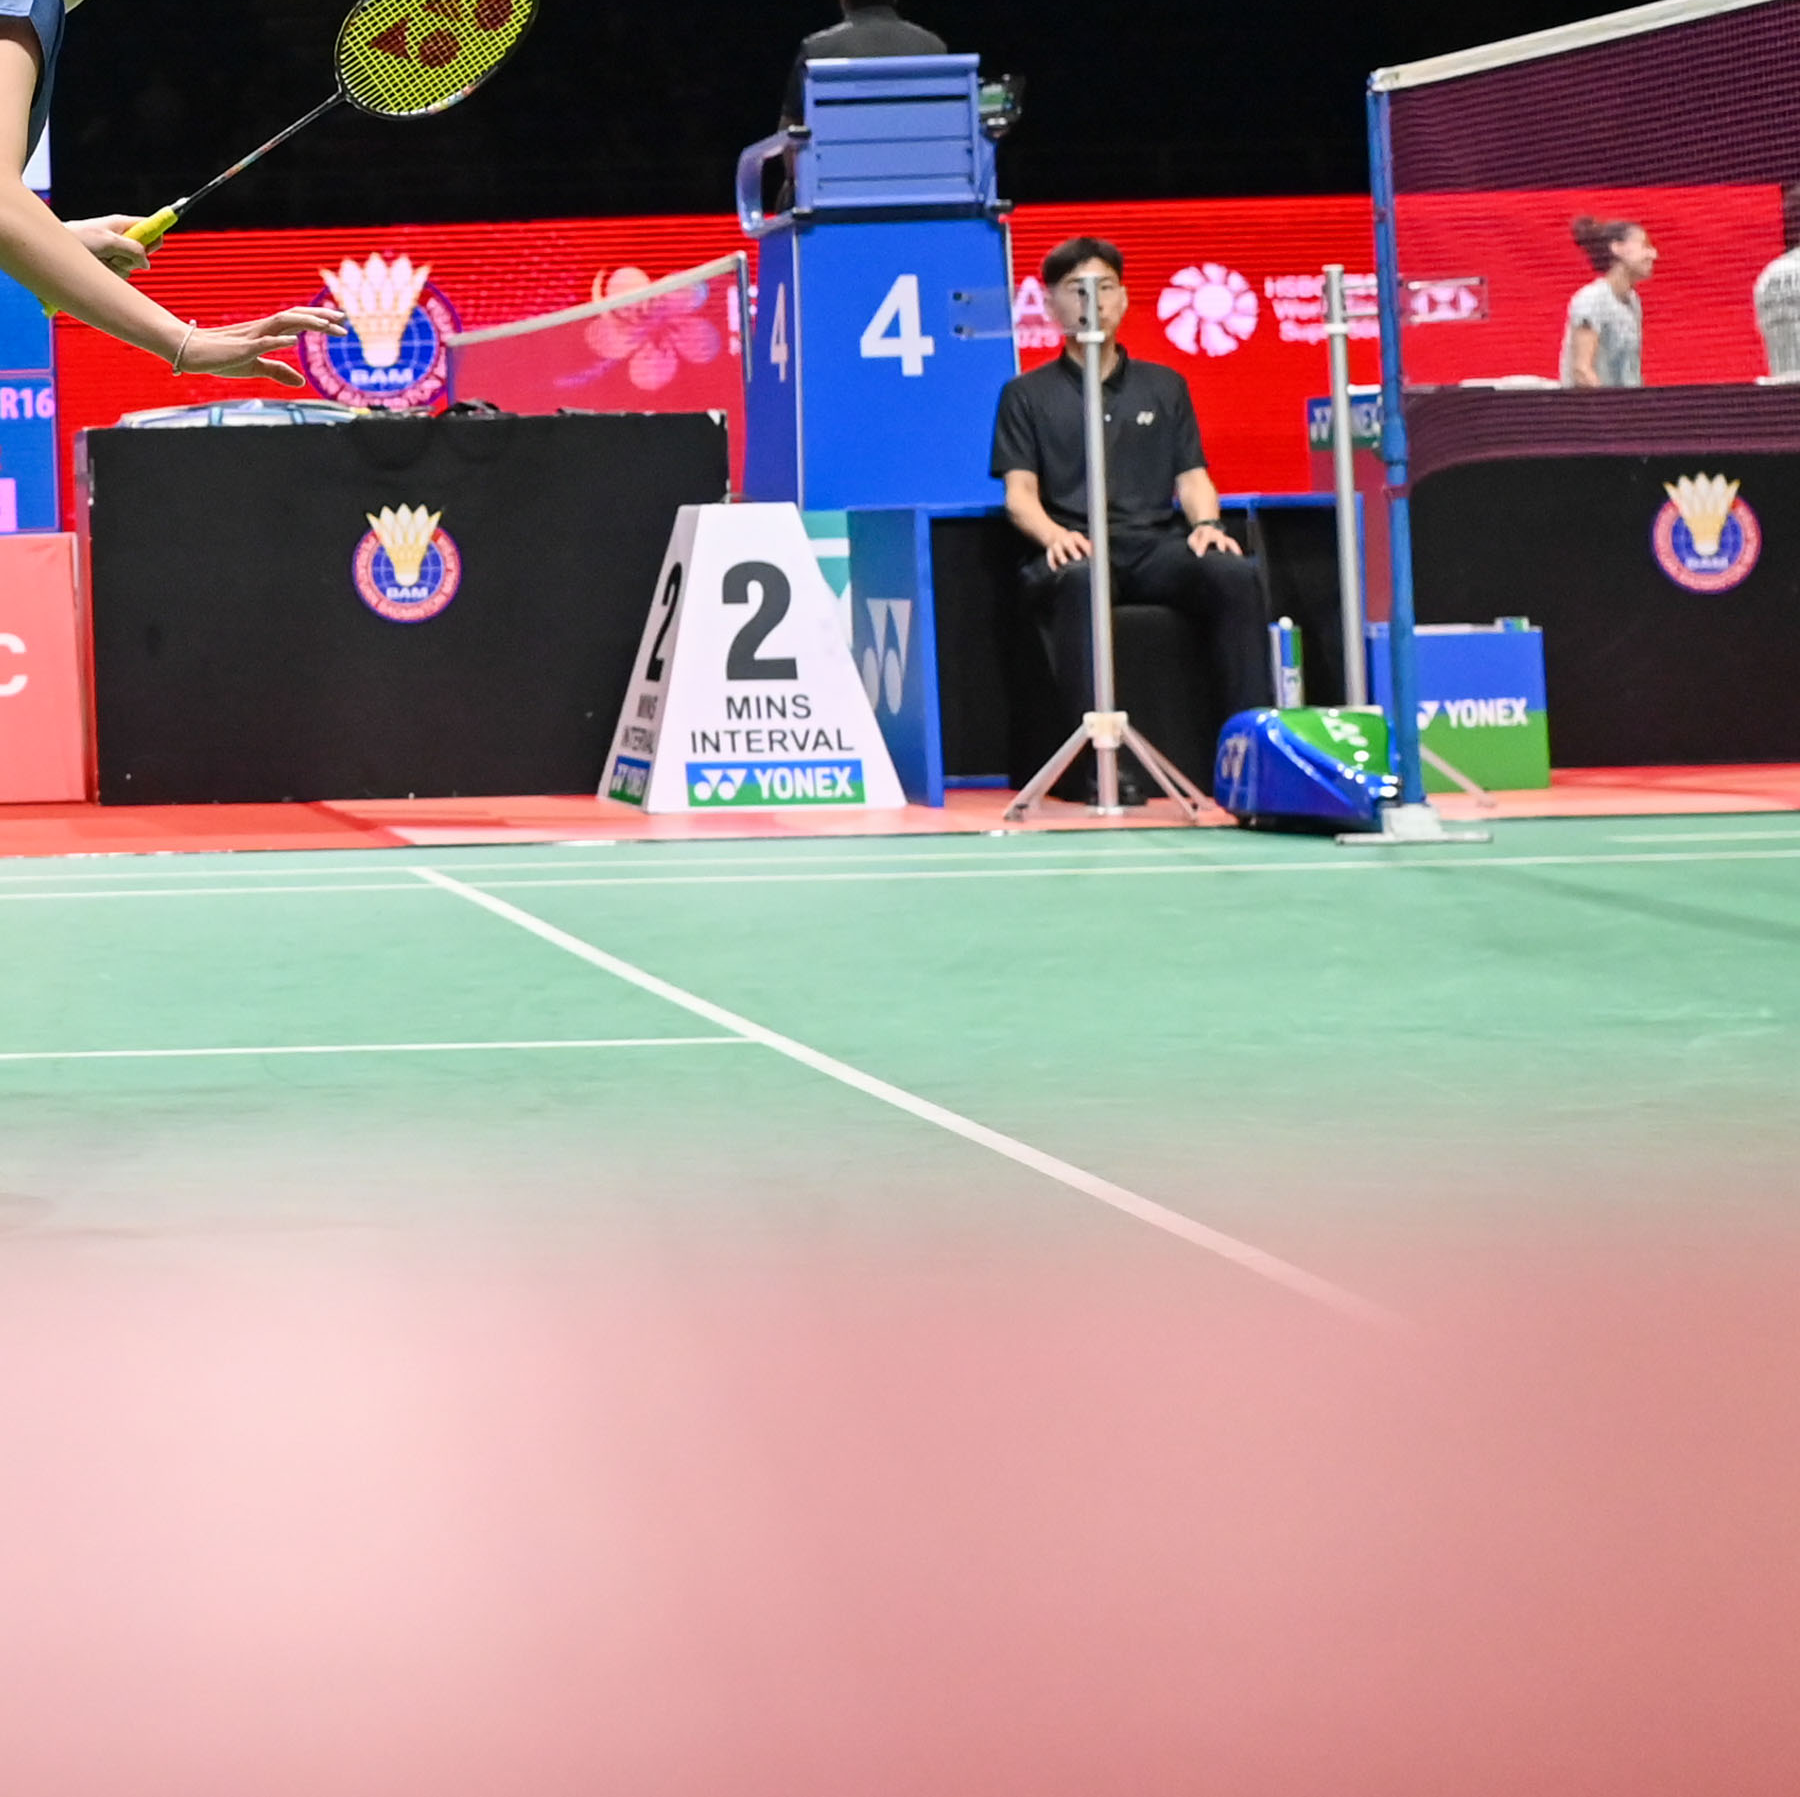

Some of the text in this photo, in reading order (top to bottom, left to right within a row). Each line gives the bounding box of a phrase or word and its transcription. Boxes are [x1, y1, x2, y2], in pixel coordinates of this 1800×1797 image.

[770, 282, 788, 382] 4
[859, 273, 935, 377] 4
[386, 586, 429, 599] BAM
[646, 562, 682, 682] 2
[722, 561, 798, 681] 2
[726, 694, 812, 720] MINS
[1444, 697, 1529, 729] YONEX
[690, 728, 855, 754] INTERVAL
[754, 766, 854, 800] YONEX
